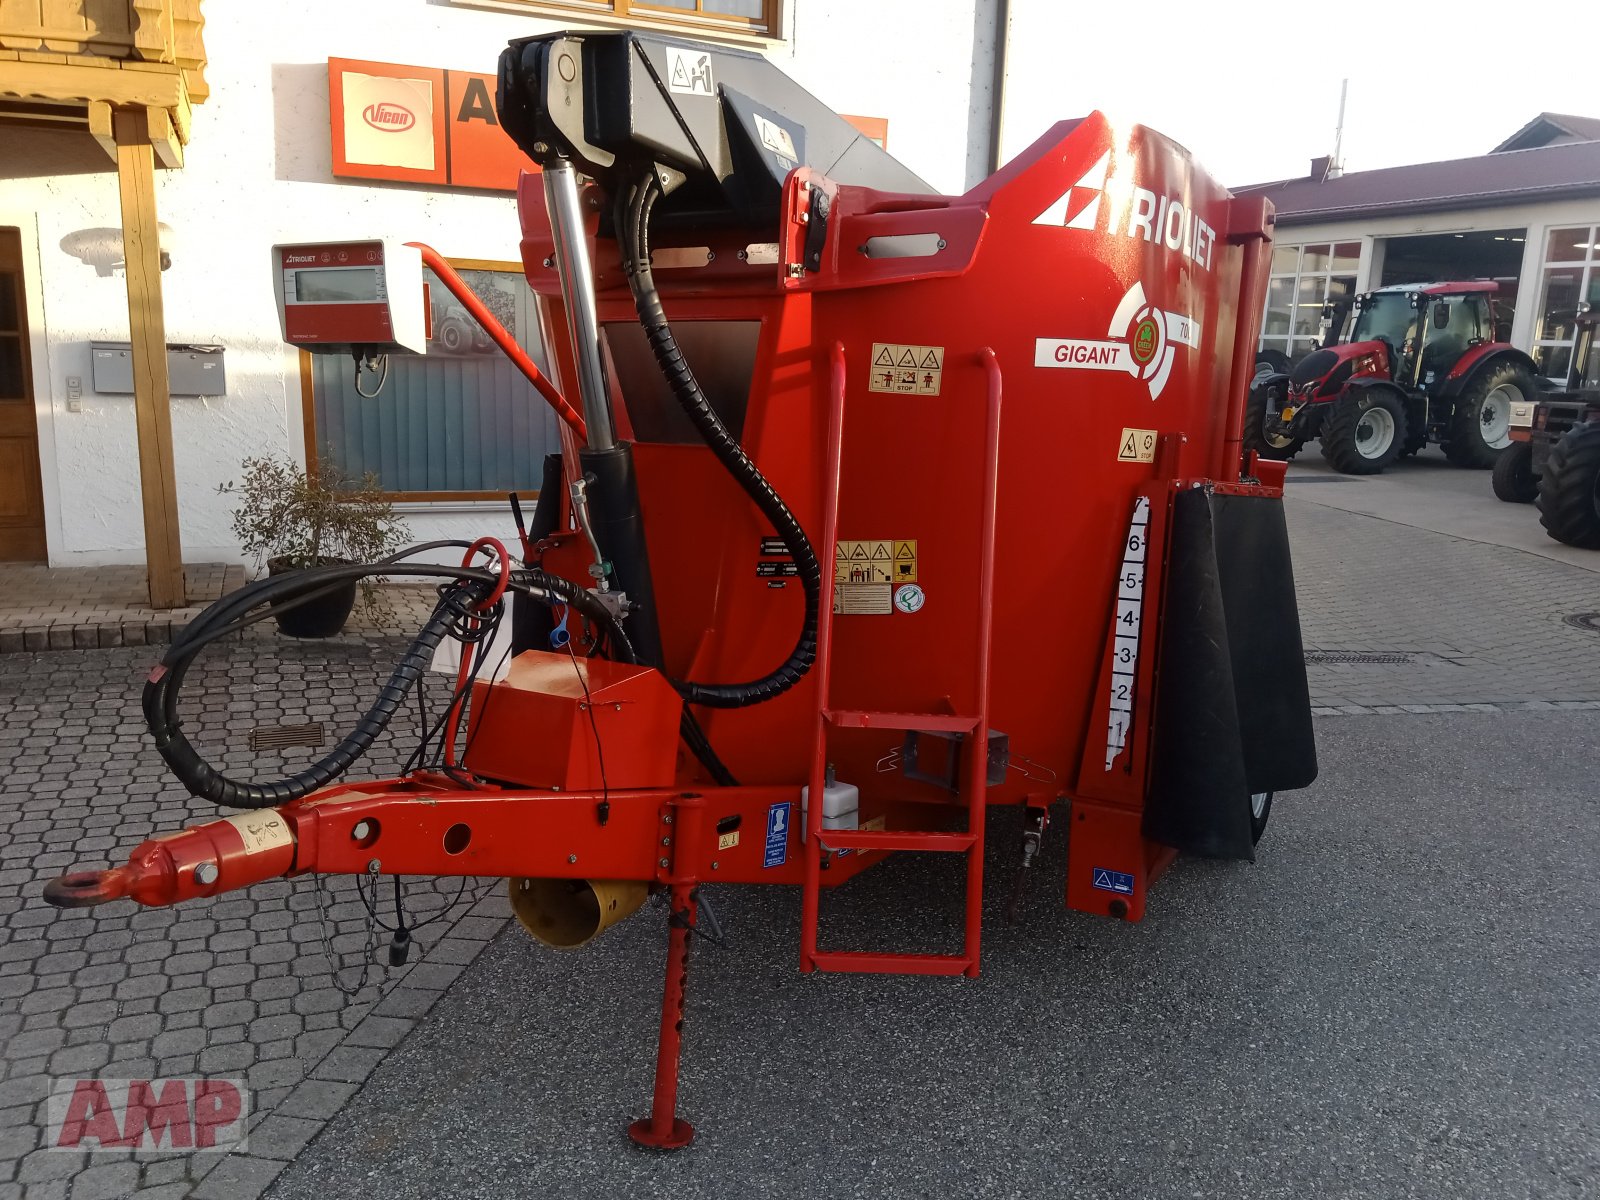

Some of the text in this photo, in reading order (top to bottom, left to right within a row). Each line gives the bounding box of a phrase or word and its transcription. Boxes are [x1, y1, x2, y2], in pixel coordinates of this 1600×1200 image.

[369, 103, 409, 126] Vicon
[1105, 177, 1216, 272] TRIOLIET
[1054, 344, 1120, 364] GIGANT
[1128, 535, 1140, 551] 6
[1126, 573, 1137, 589] 5
[1122, 610, 1134, 627] 4
[1119, 647, 1131, 663] 3
[1117, 684, 1128, 701] 2
[1115, 721, 1123, 737] 1
